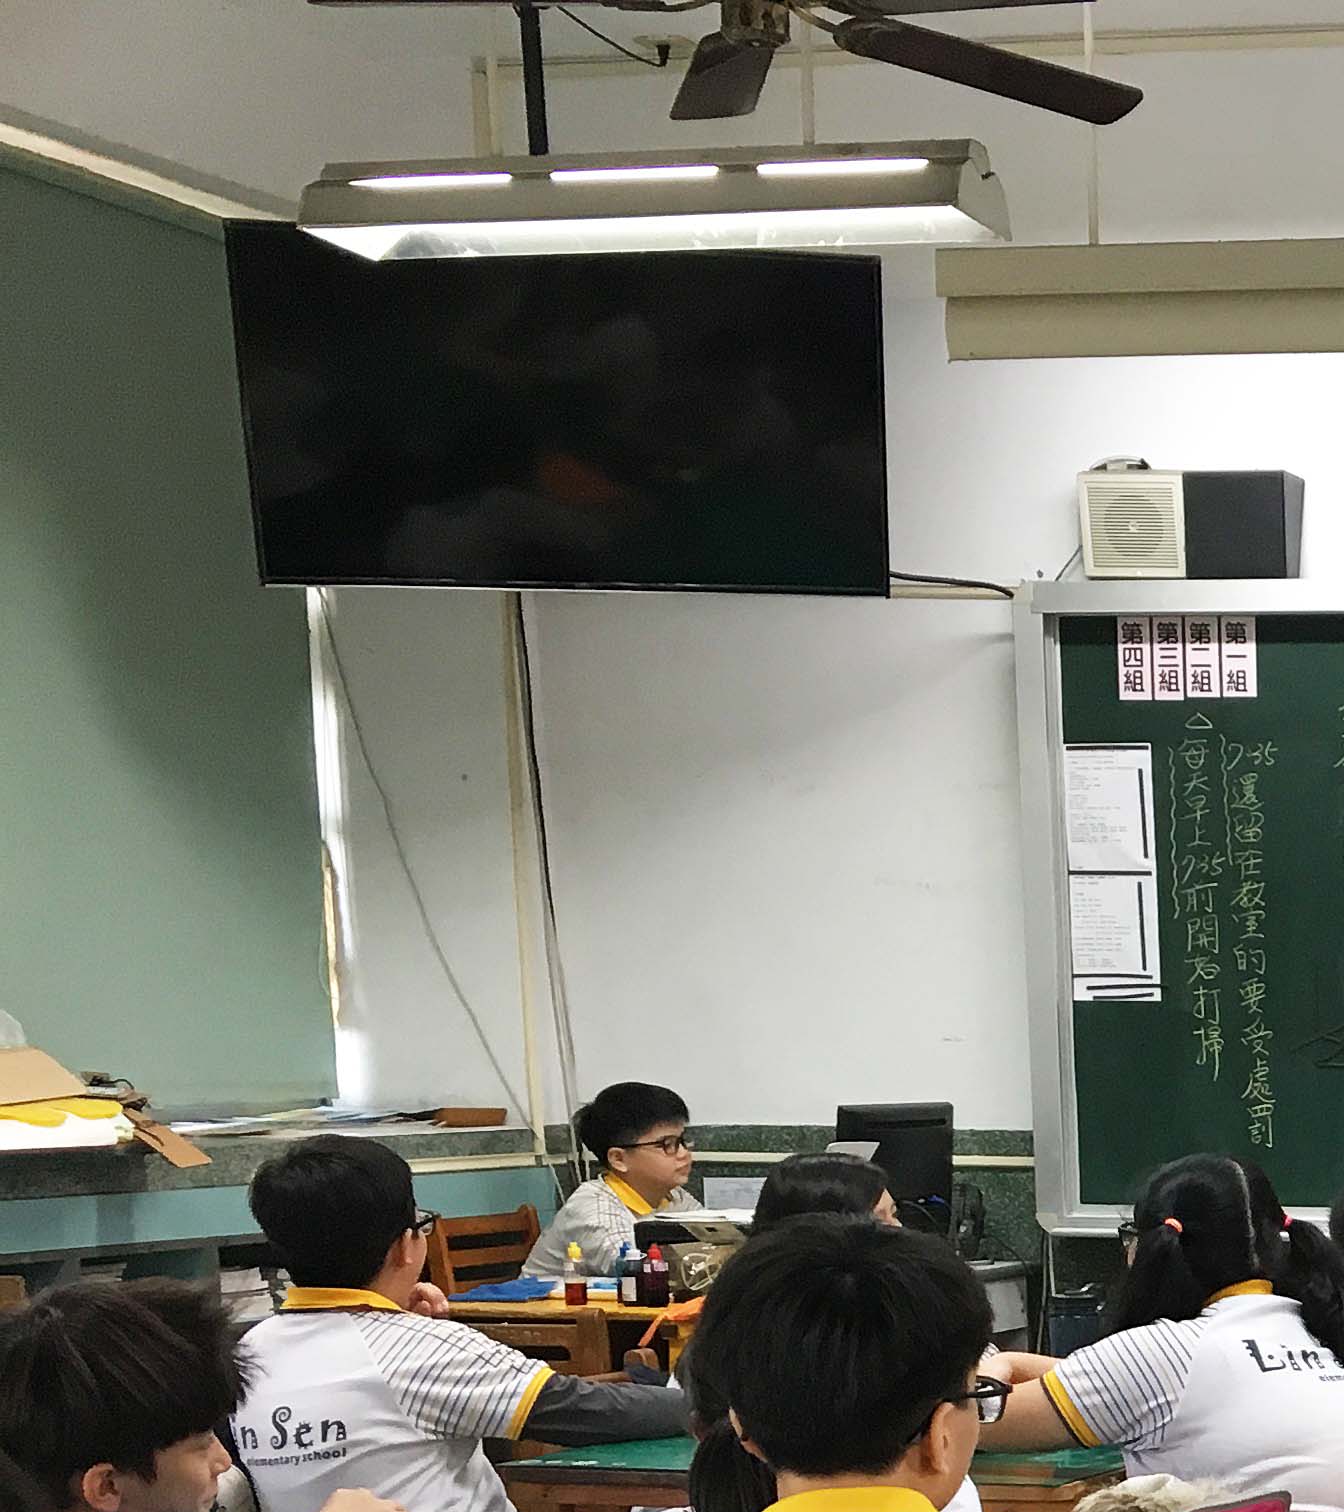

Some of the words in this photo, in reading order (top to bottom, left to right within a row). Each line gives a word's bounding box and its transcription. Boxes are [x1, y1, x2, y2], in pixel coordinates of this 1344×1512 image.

[1120, 622, 1146, 693] 第四組
[1156, 622, 1181, 693] 第三組
[1189, 622, 1215, 693] 第二組
[1224, 621, 1250, 692] 第一組
[1241, 1339, 1326, 1373] Lin
[270, 1406, 347, 1450] Sen
[302, 1447, 347, 1463] school
